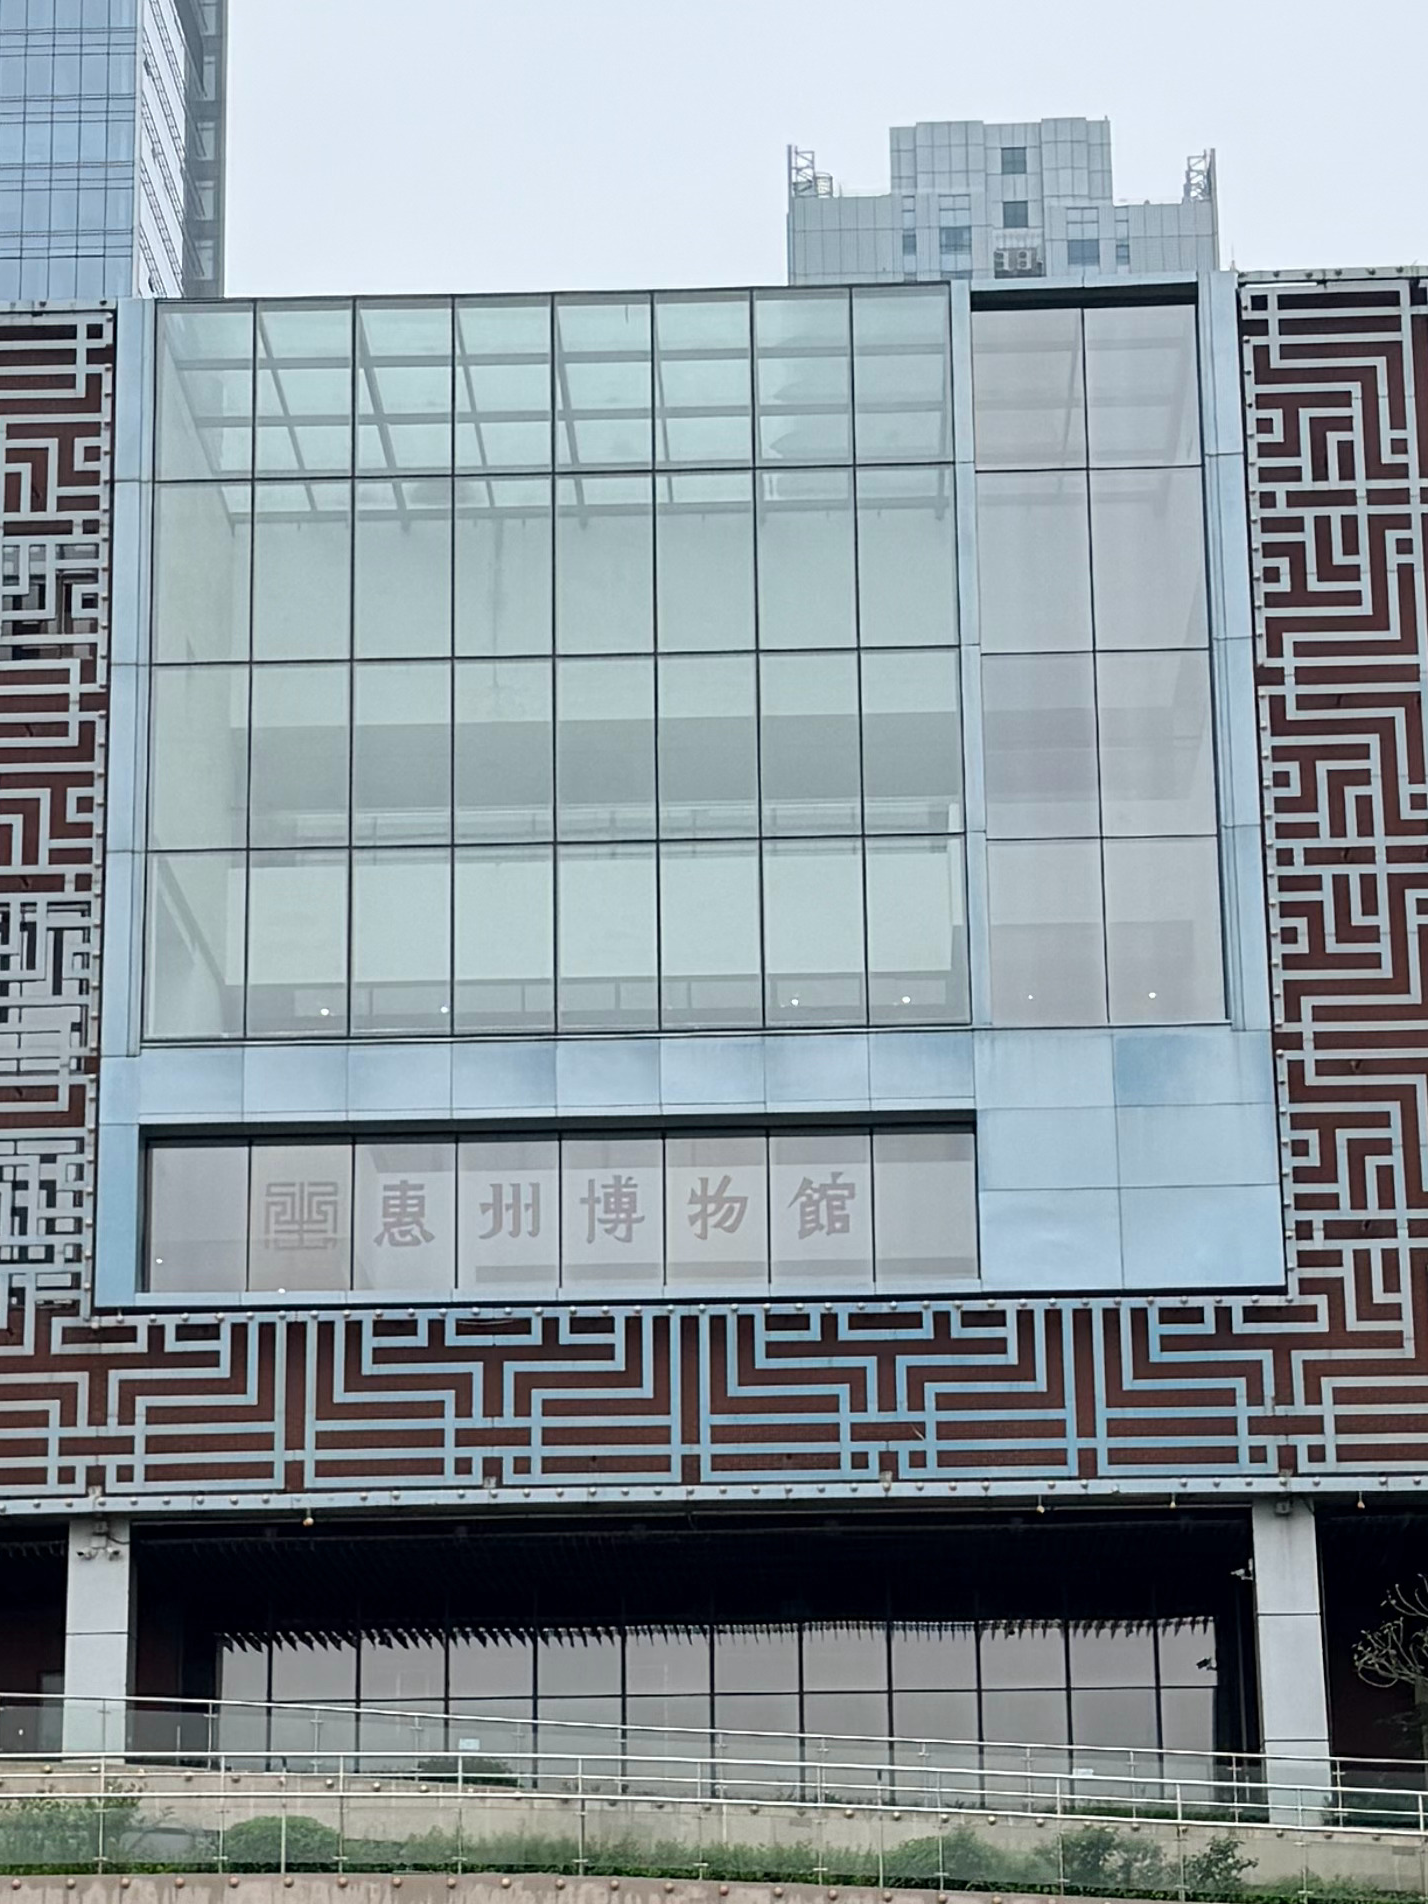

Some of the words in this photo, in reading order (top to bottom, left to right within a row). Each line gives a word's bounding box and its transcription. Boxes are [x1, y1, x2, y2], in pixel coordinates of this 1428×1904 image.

[373, 1170, 858, 1248] 惠州博物館
